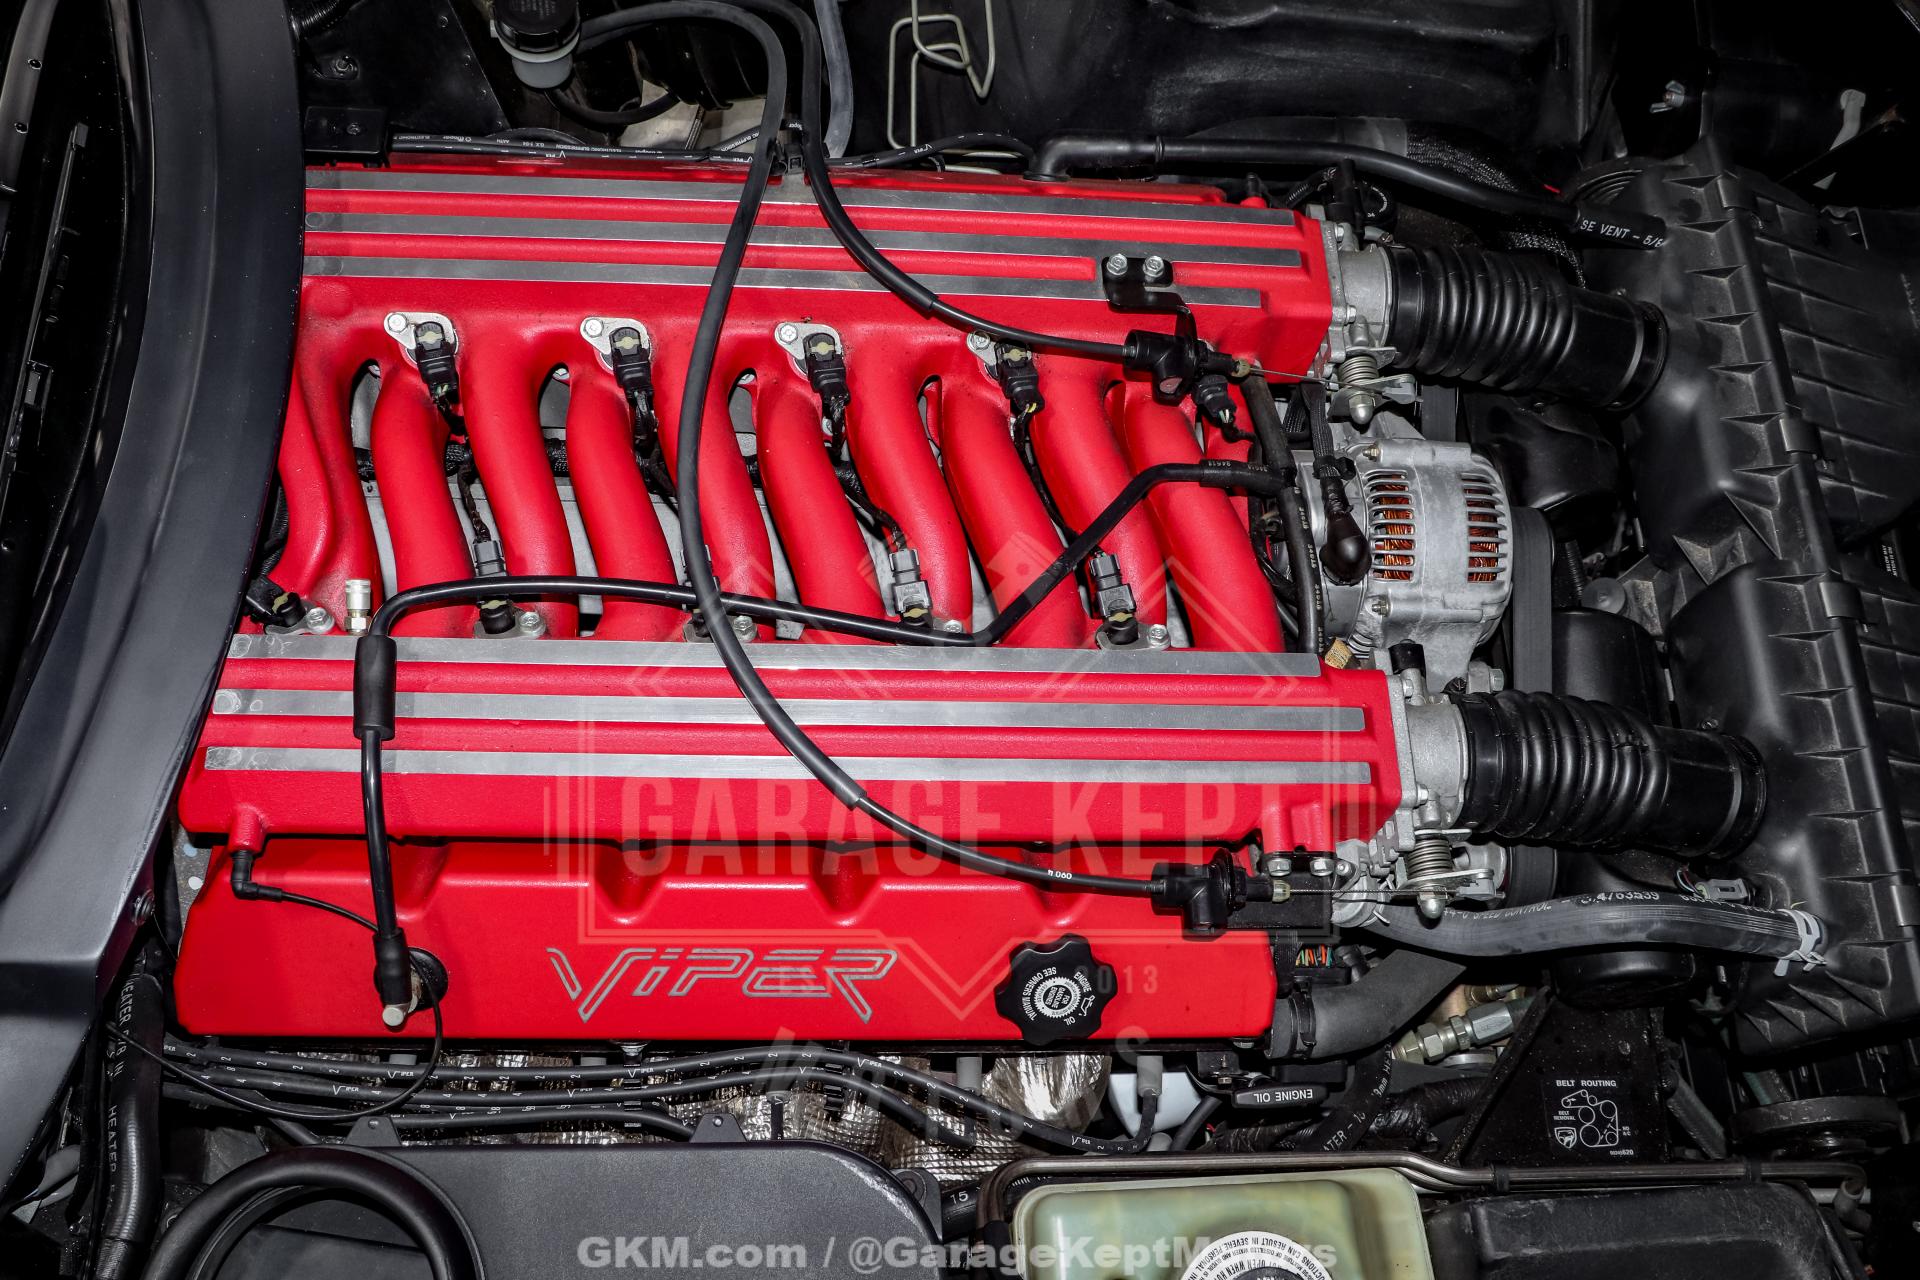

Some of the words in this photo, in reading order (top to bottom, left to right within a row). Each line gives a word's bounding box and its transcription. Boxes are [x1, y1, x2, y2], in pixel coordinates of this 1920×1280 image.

[1600, 223, 1631, 239] VENT
[1042, 966, 1057, 977] SEE
[547, 948, 898, 1024] VIPER
[1022, 972, 1044, 997] OWNERS
[1073, 971, 1092, 993] ENGINE
[116, 979, 135, 1024] HEATER
[1021, 996, 1038, 1022] MANUAL
[1063, 1016, 1076, 1026] OIL
[1555, 1079, 1576, 1088] BELT
[1580, 1079, 1617, 1088] ROUTING
[1253, 1092, 1271, 1103] OIL
[1275, 1088, 1313, 1102] ENGINE
[1260, 1238, 1287, 1249] RESULT
[1195, 1245, 1223, 1270] PERSONAL
[1221, 1251, 1232, 1260] AND
[1232, 1247, 1249, 1256] WATER
[1287, 1246, 1300, 1259] CAN
[1225, 1260, 1245, 1276] WHEN
